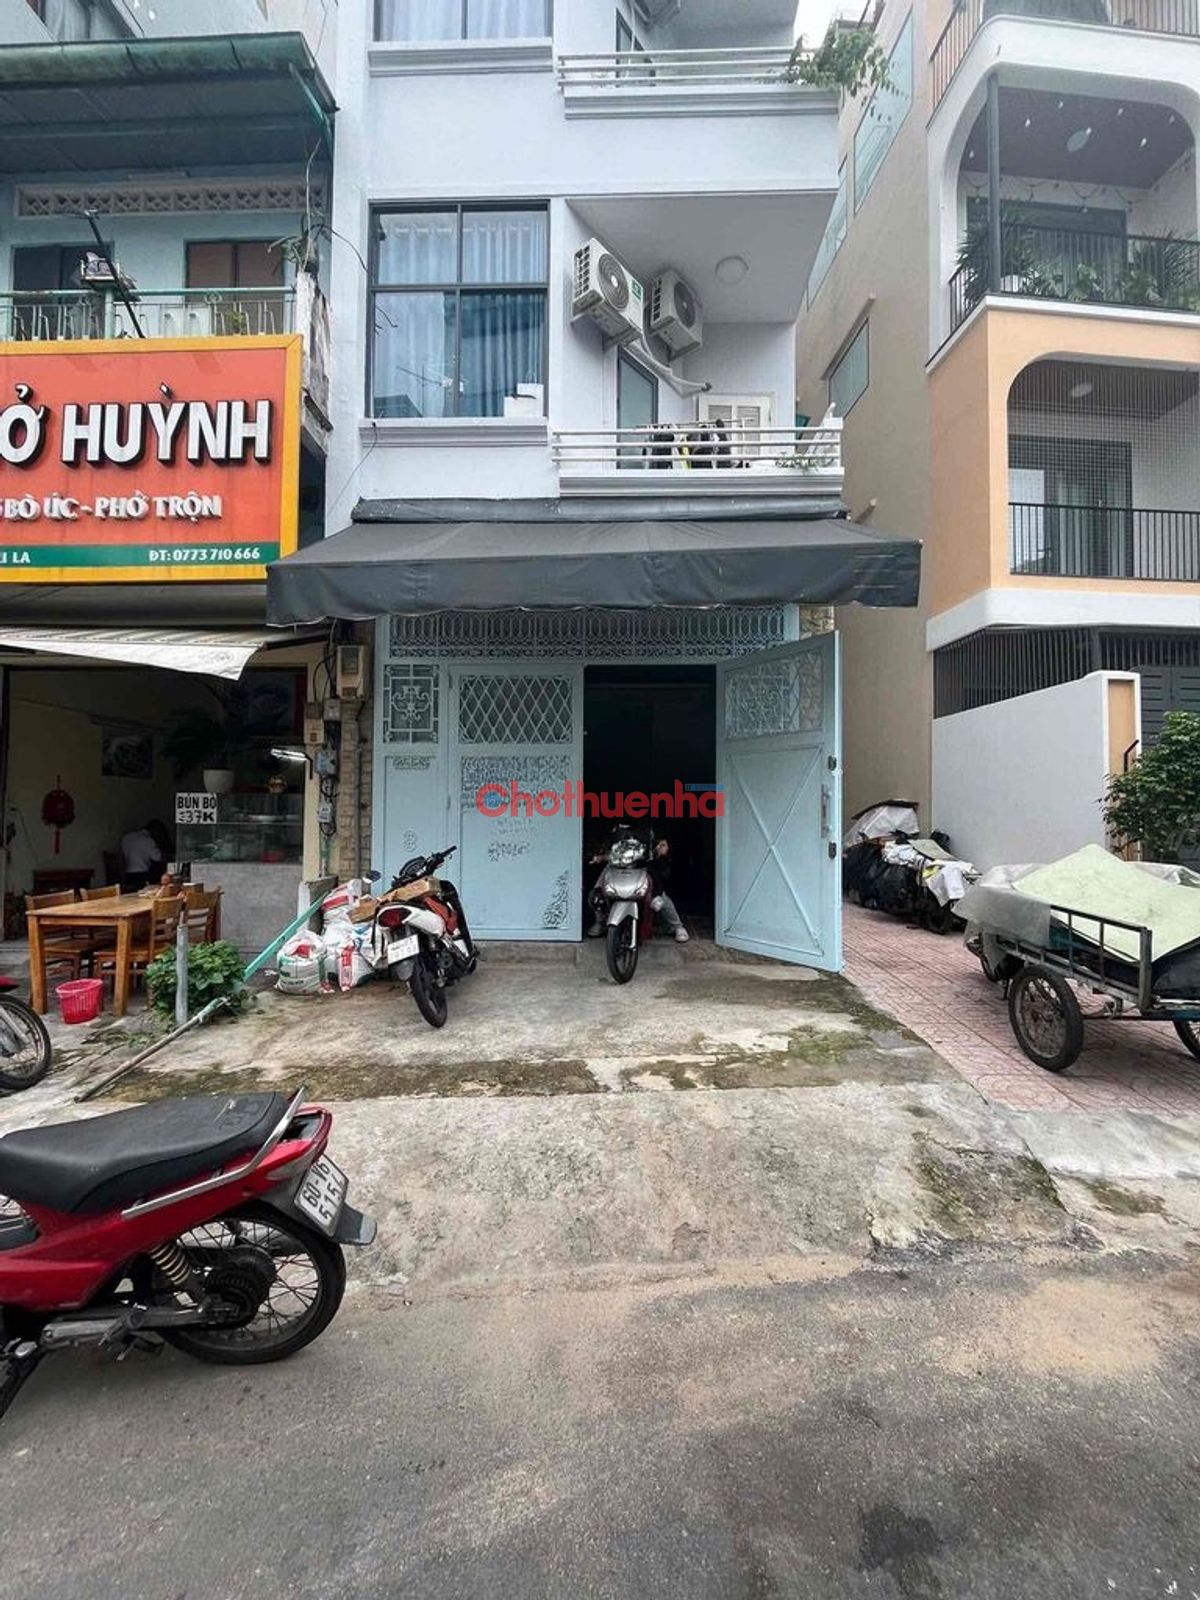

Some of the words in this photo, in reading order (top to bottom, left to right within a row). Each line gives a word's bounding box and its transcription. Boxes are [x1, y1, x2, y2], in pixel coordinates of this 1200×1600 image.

[61, 383, 271, 467] HUỲNH
[152, 490, 222, 523] TRỘN
[209, 548, 232, 560] 710
[233, 547, 260, 559] 666
